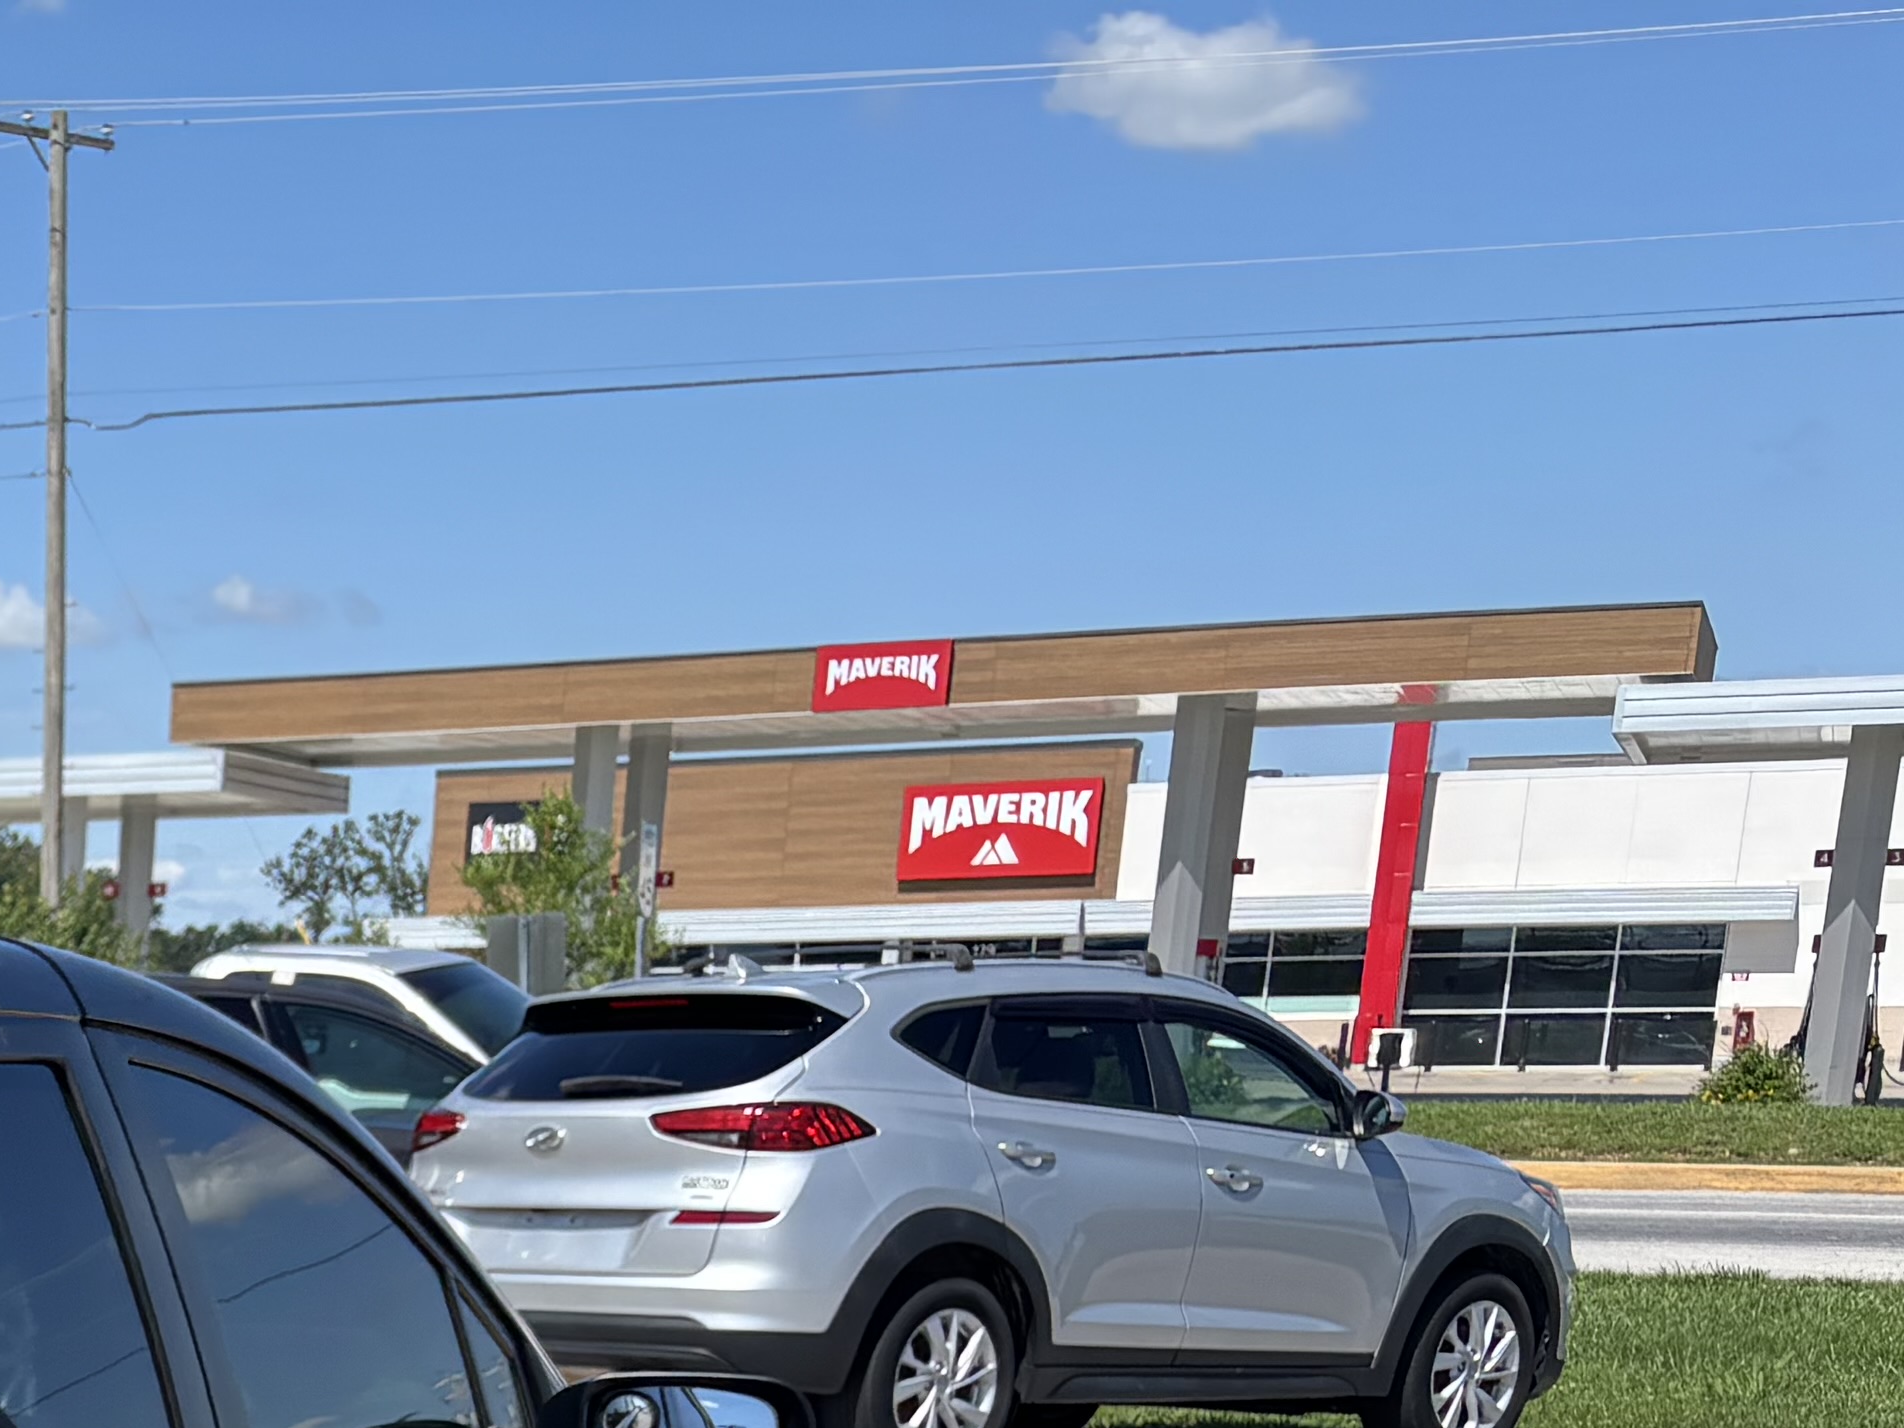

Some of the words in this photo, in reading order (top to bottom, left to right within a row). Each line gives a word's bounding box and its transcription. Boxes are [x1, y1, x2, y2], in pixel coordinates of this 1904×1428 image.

[825, 654, 940, 696] MAVERIK
[908, 789, 1094, 855] MAVERIK
[1820, 852, 1829, 863] 4
